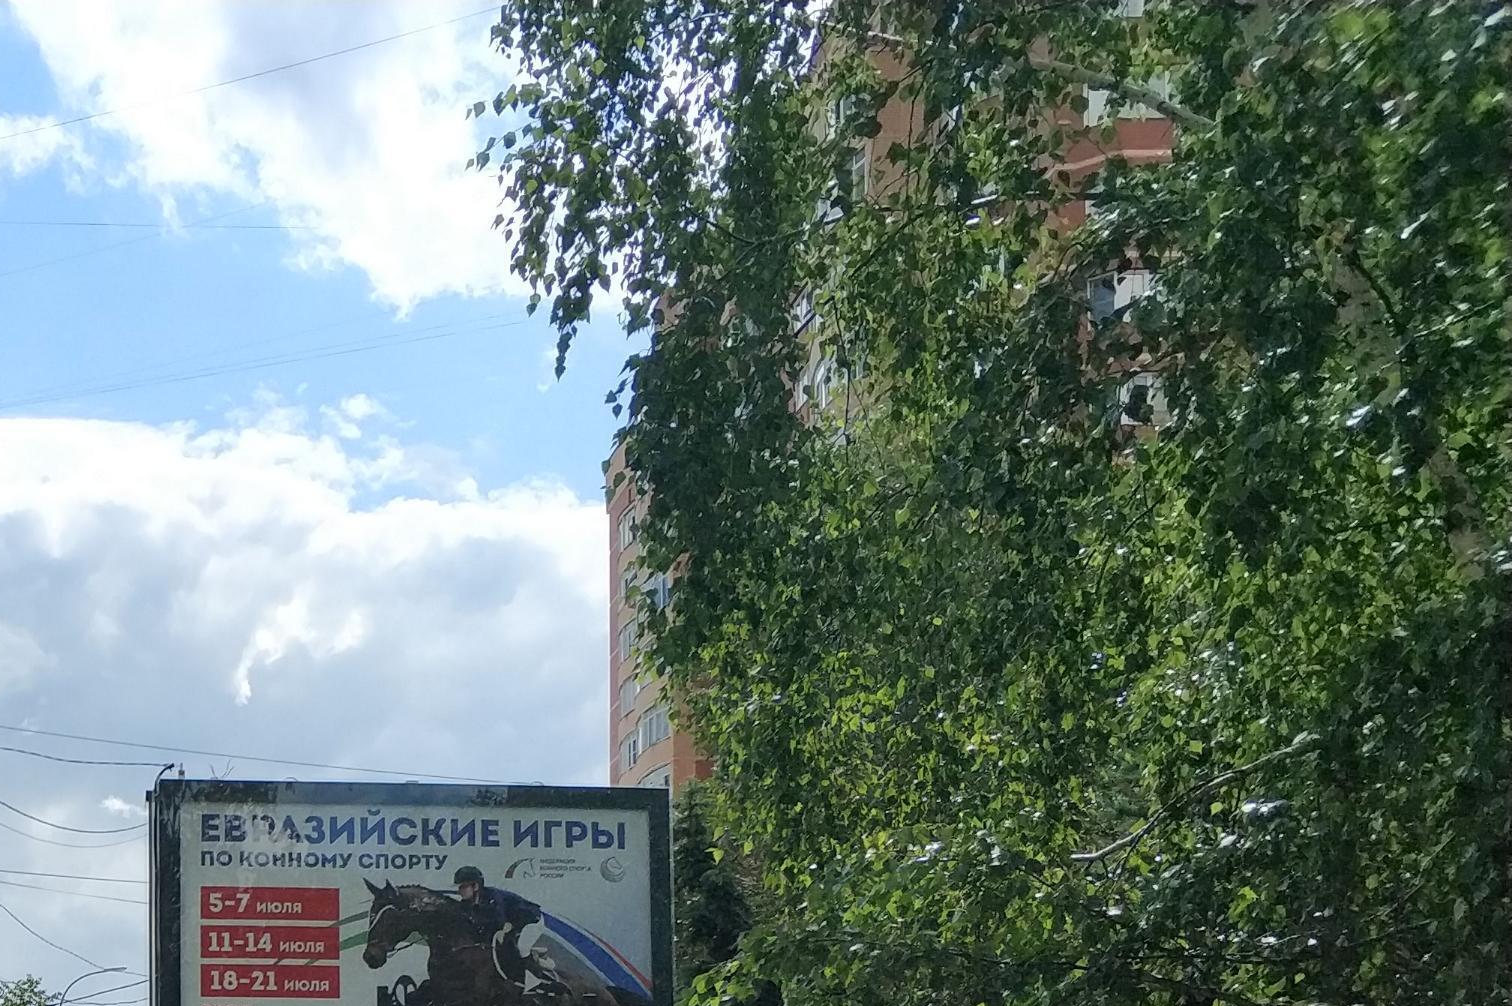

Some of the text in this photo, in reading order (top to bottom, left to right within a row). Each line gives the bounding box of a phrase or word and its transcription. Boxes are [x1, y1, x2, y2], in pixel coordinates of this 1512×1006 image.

[201, 809, 626, 849] ЕВРАЗИЙСКИЕ ИГРЫ
[201, 851, 449, 870] ПО КОННОМУ СПОРТУ
[208, 892, 302, 914] 5-7 июля
[208, 932, 325, 953] 11-14 июля
[210, 970, 330, 991] 18-21 июля
